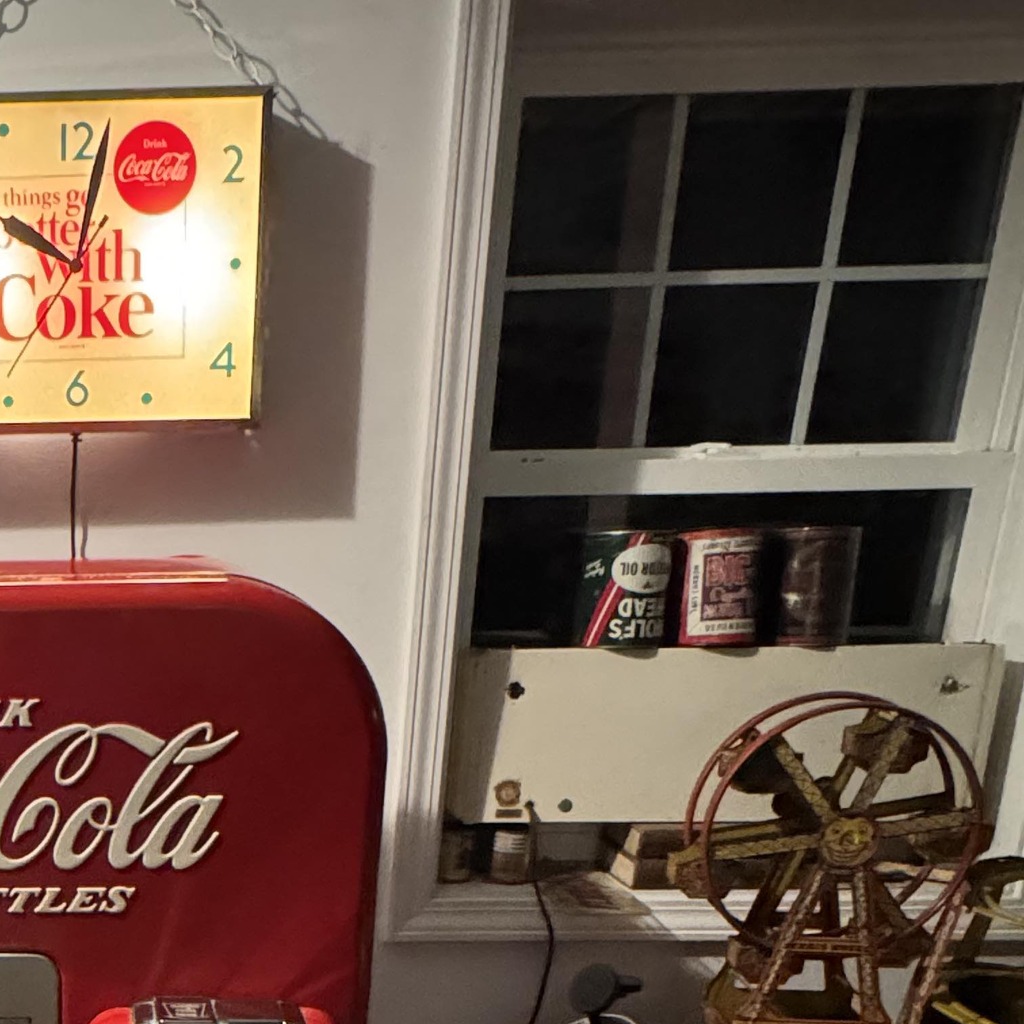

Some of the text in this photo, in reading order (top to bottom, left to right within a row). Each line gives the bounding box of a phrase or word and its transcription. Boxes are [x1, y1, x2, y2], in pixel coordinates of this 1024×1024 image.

[60, 121, 94, 161] 12
[143, 138, 168, 149] Drink
[223, 145, 245, 183] 2
[4, 187, 61, 210] things
[37, 229, 144, 285] with
[209, 342, 236, 377] 4
[66, 370, 89, 407] 6
[620, 562, 638, 576] OIL
